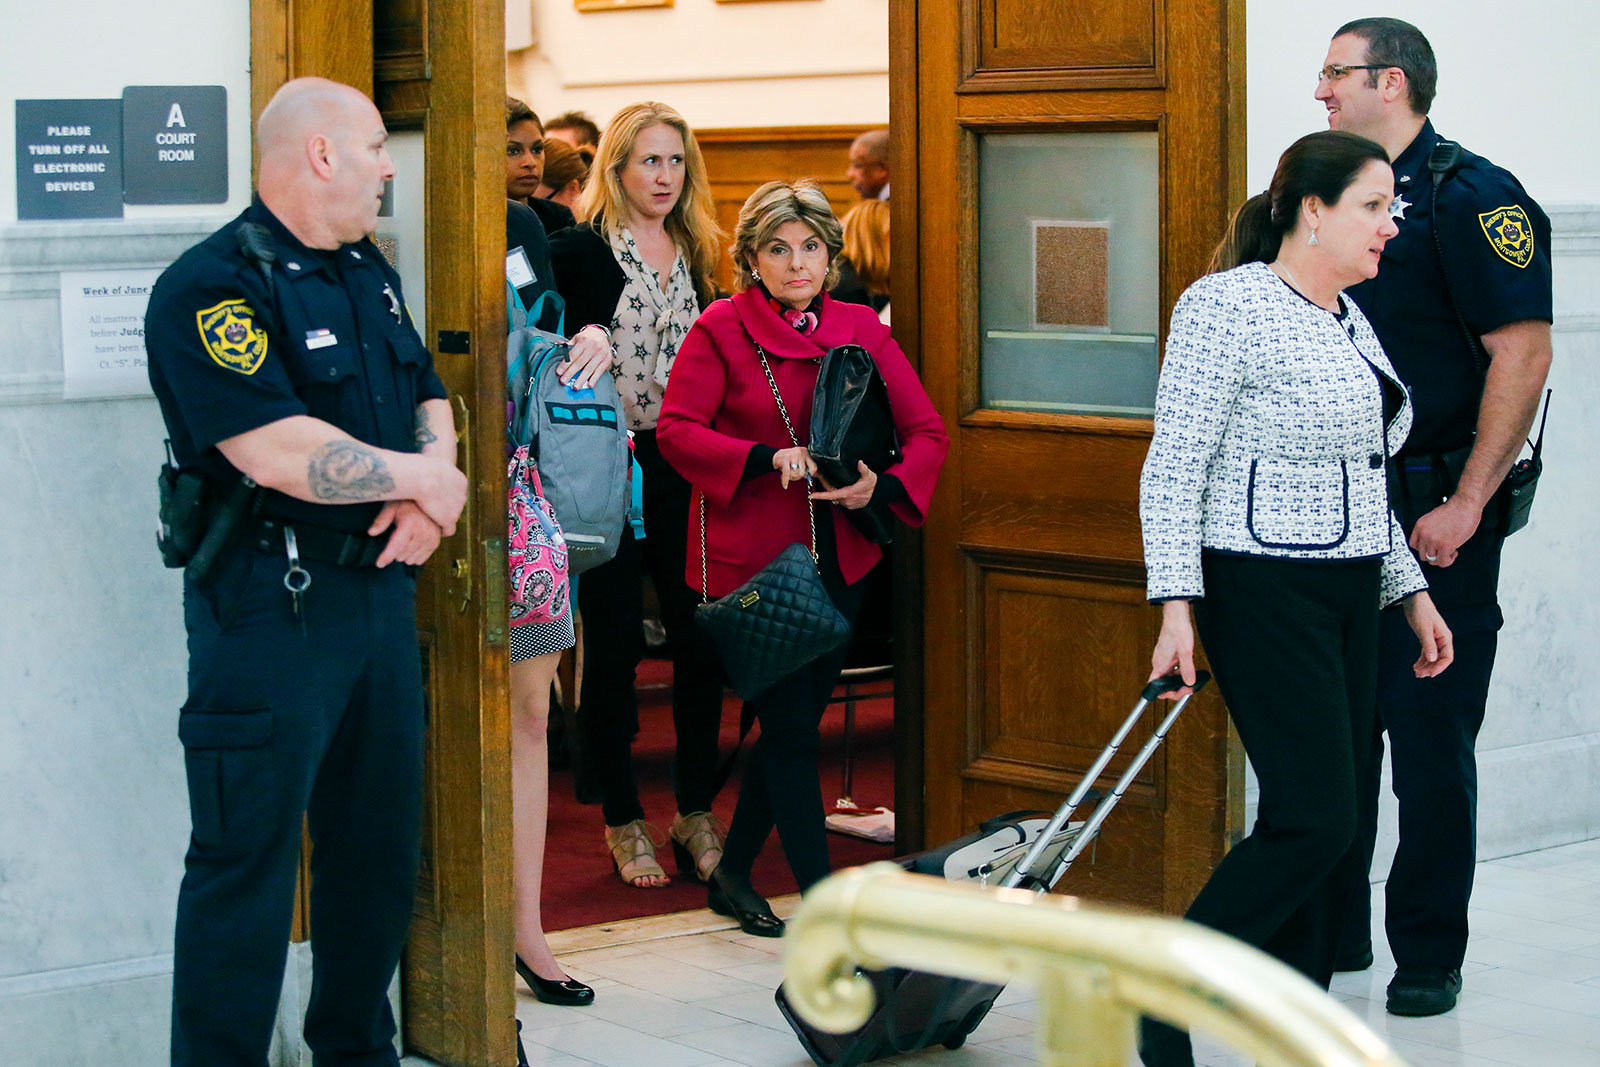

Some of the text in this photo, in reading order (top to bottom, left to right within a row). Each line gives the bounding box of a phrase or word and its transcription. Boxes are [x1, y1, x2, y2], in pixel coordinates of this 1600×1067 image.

[165, 103, 187, 127] A
[47, 126, 91, 137] PLEASE
[156, 133, 197, 145] COURT
[29, 144, 110, 155] TURN OFF ALL
[158, 150, 195, 162] ROOM
[33, 163, 106, 174] ELECTRONIC
[45, 182, 95, 192] DEVICES
[1507, 210, 1524, 220] OFFICE
[1494, 237, 1526, 257] MONTGOMERY
[82, 286, 149, 296] Week of June
[89, 315, 101, 323] All
[90, 329, 118, 337] before
[95, 345, 116, 353] have
[118, 344, 139, 352] been
